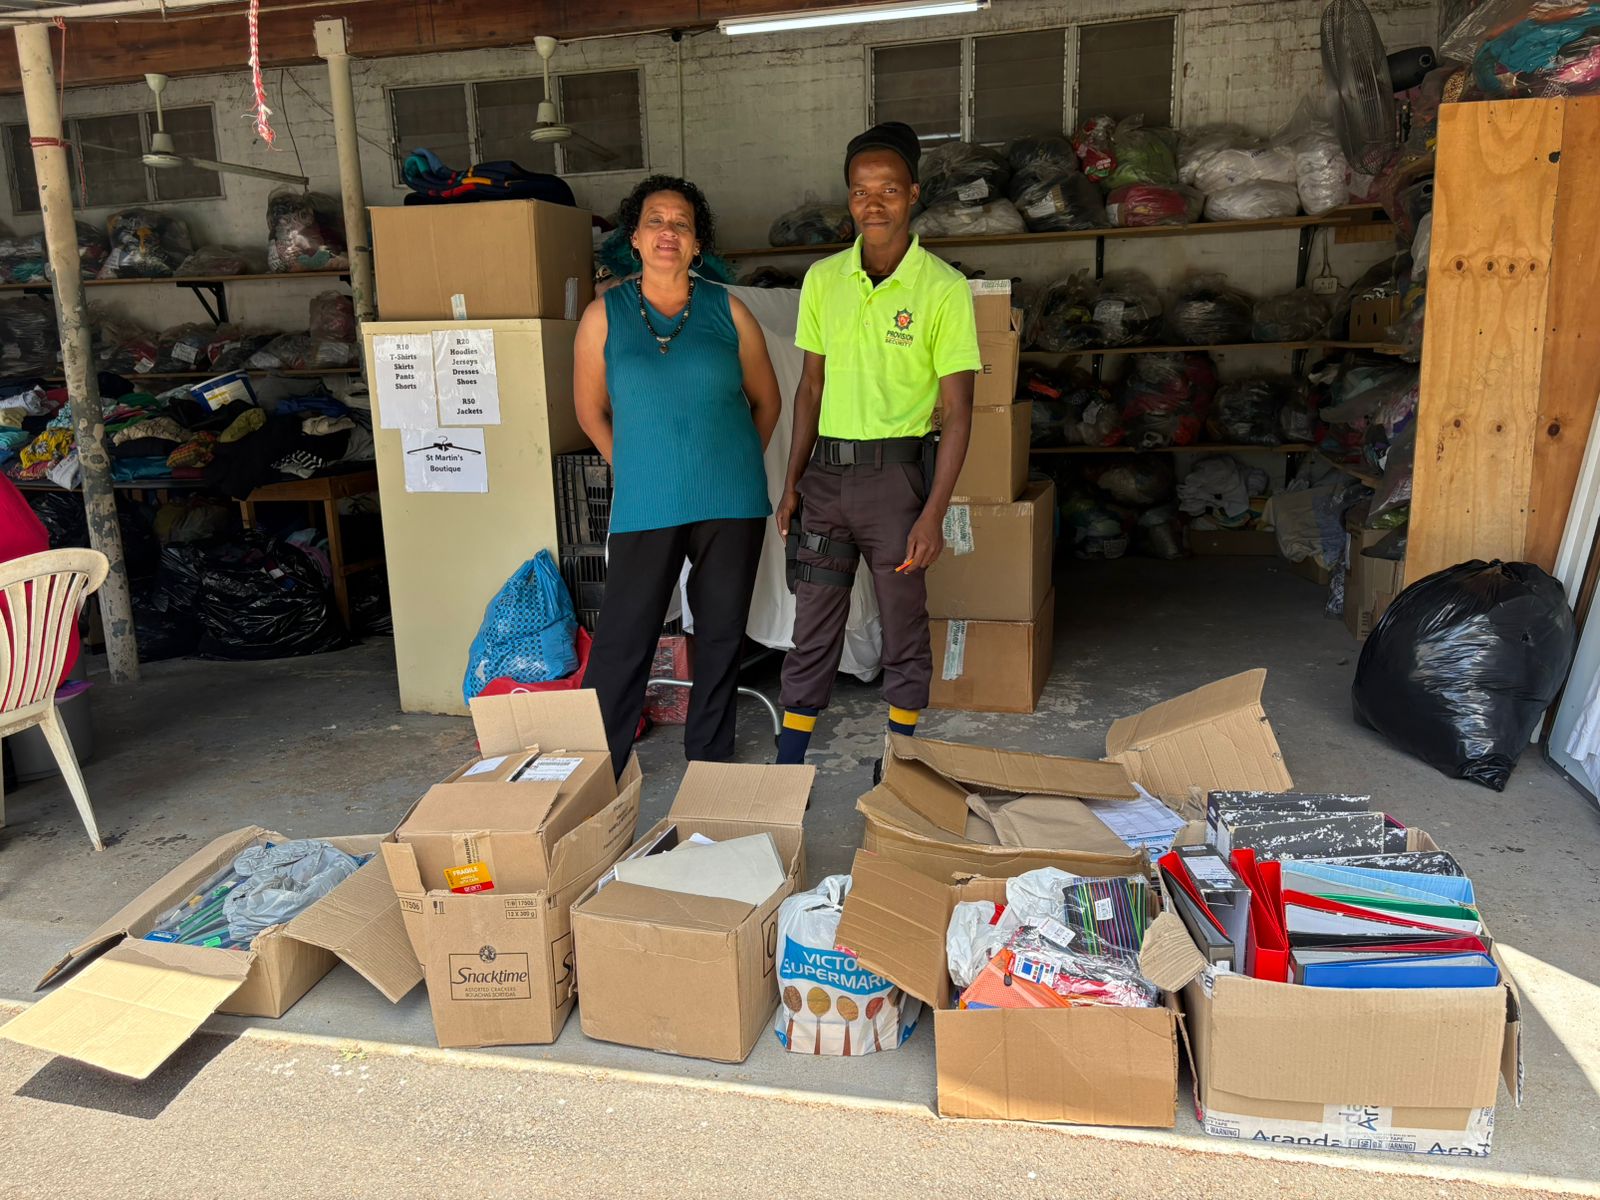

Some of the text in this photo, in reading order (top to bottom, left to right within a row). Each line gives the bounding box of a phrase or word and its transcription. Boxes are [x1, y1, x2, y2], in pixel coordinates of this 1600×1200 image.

[886, 330, 914, 342] PROVISION
[885, 338, 913, 348] SECURITY
[450, 348, 478, 356] Hoodies
[390, 353, 417, 361] T-Shirts
[451, 358, 478, 366] Jerseys
[452, 368, 480, 376] Dresses
[425, 453, 464, 462] St Martin's
[430, 465, 461, 473] Boutique
[452, 866, 479, 877] FRAGILE
[401, 900, 421, 911] 17506
[451, 967, 528, 986] Snacktime
[1210, 1127, 1238, 1137] WARNING
